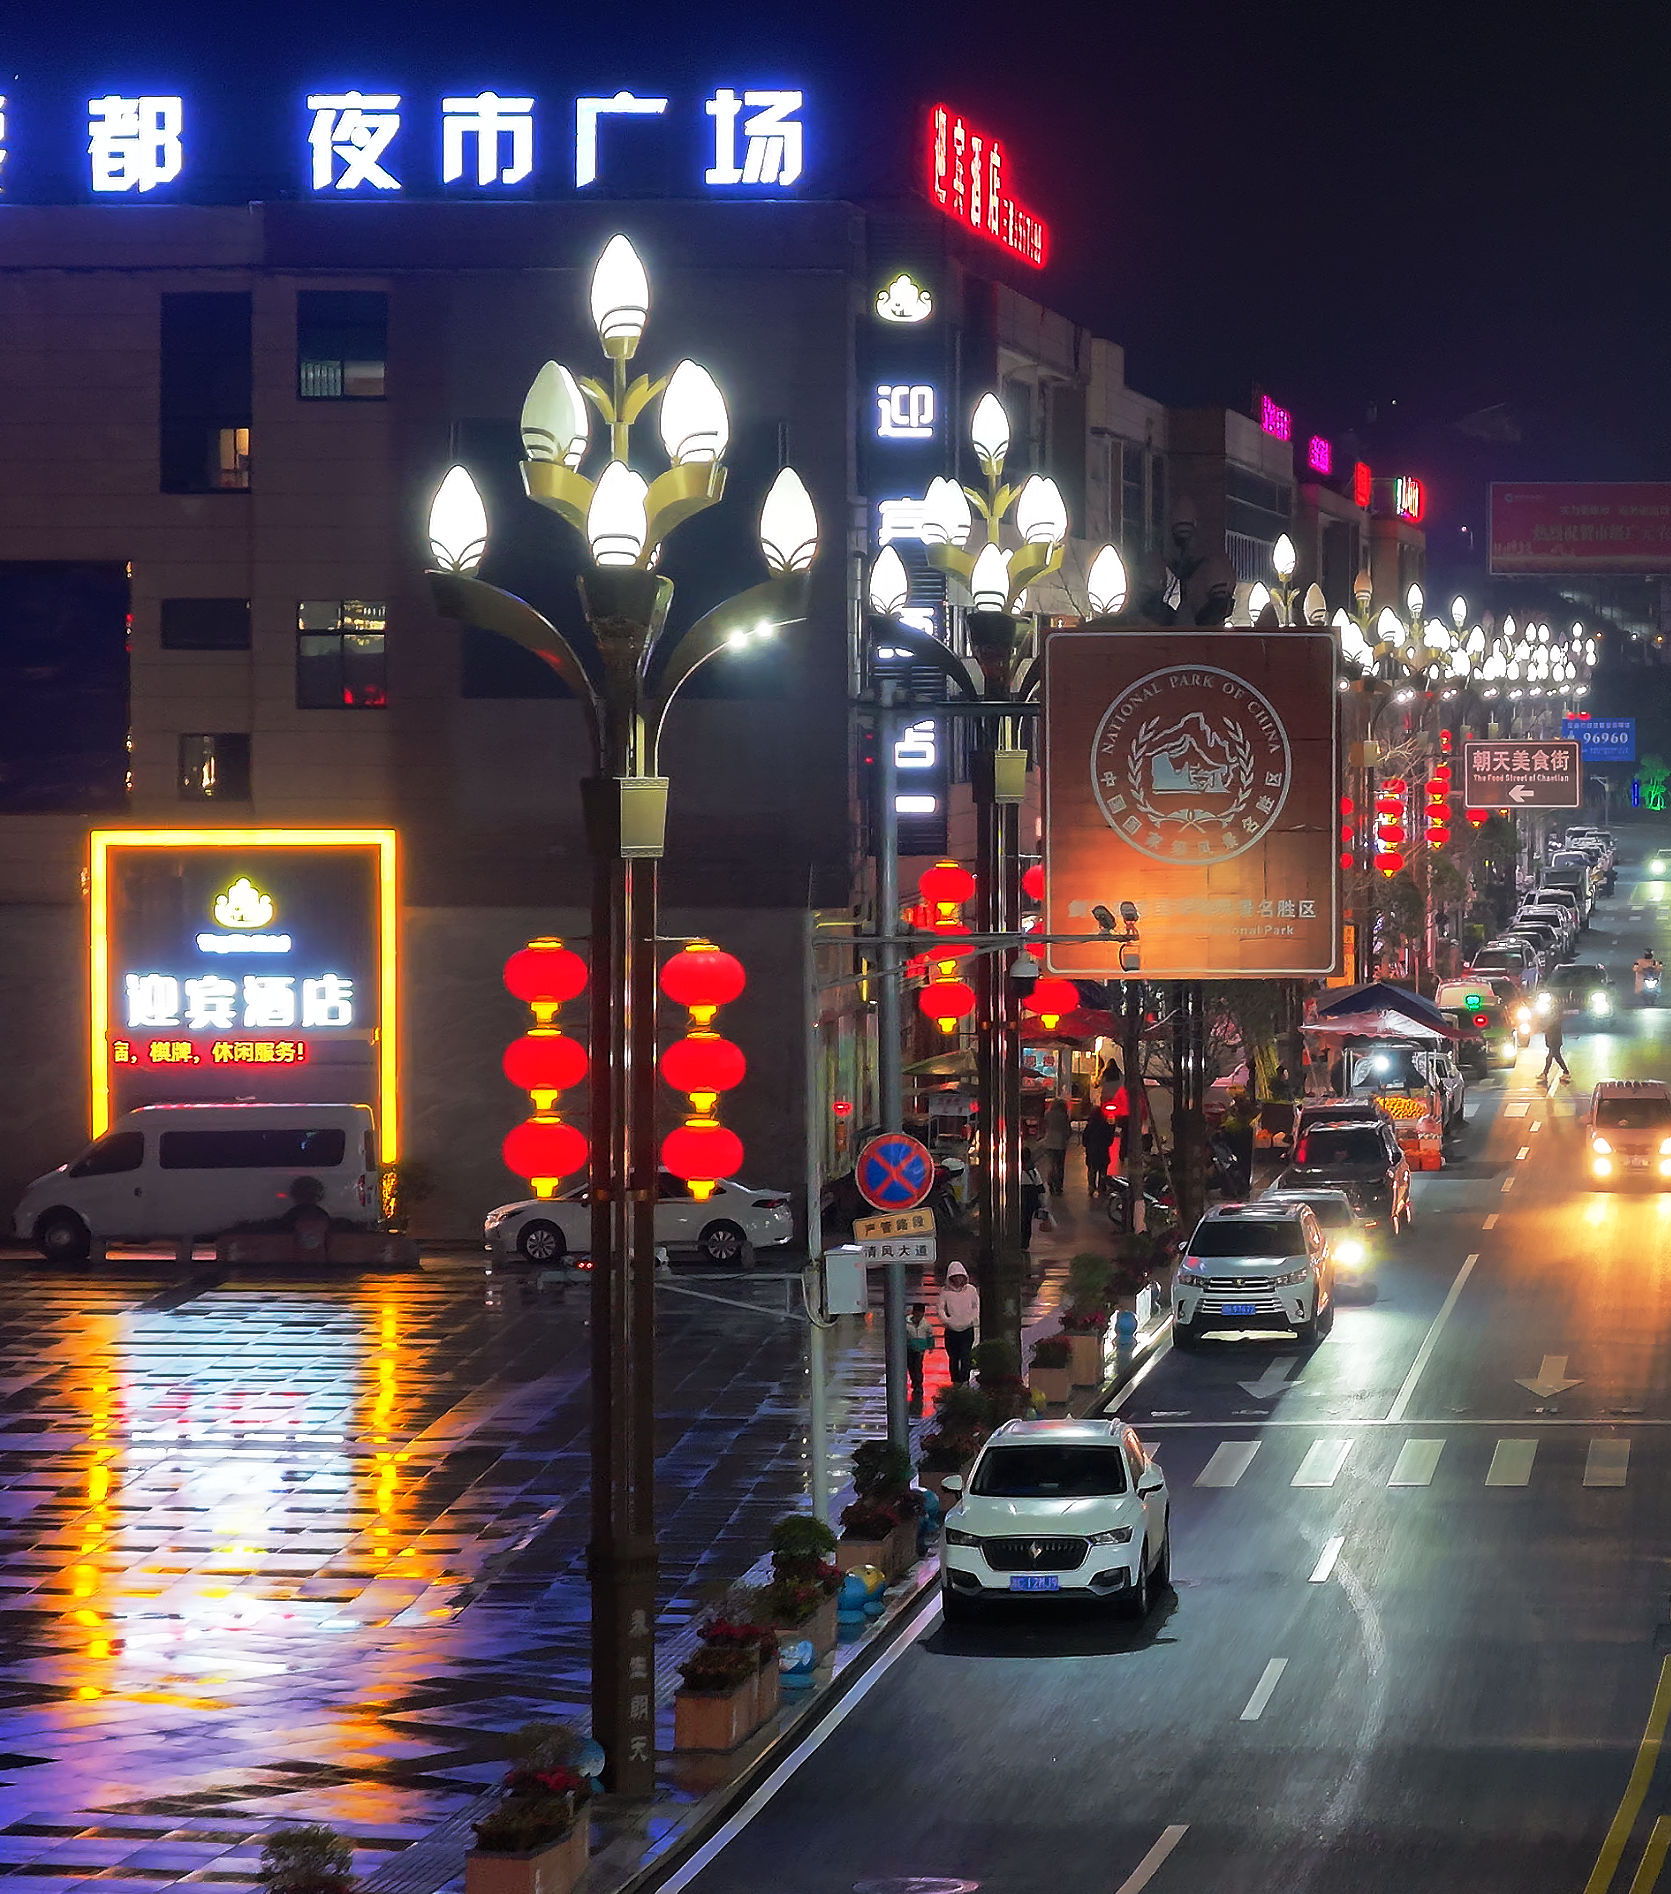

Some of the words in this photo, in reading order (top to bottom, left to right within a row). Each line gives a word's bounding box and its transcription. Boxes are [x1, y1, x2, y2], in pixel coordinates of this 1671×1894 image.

[306, 90, 803, 192] 夜市广场
[1100, 683, 1163, 756] NATIONAL
[1168, 673, 1216, 690] PARK
[1221, 681, 1246, 700] OF
[1246, 699, 1284, 755] CHINA
[1582, 732, 1629, 745] 96960
[1472, 750, 1570, 772] 朝天美食街
[1473, 774, 1487, 782] The
[1487, 774, 1504, 782] Food
[1505, 774, 1528, 782] Street
[1263, 924, 1295, 936] Park
[125, 972, 354, 1029] 迎宾酒店
